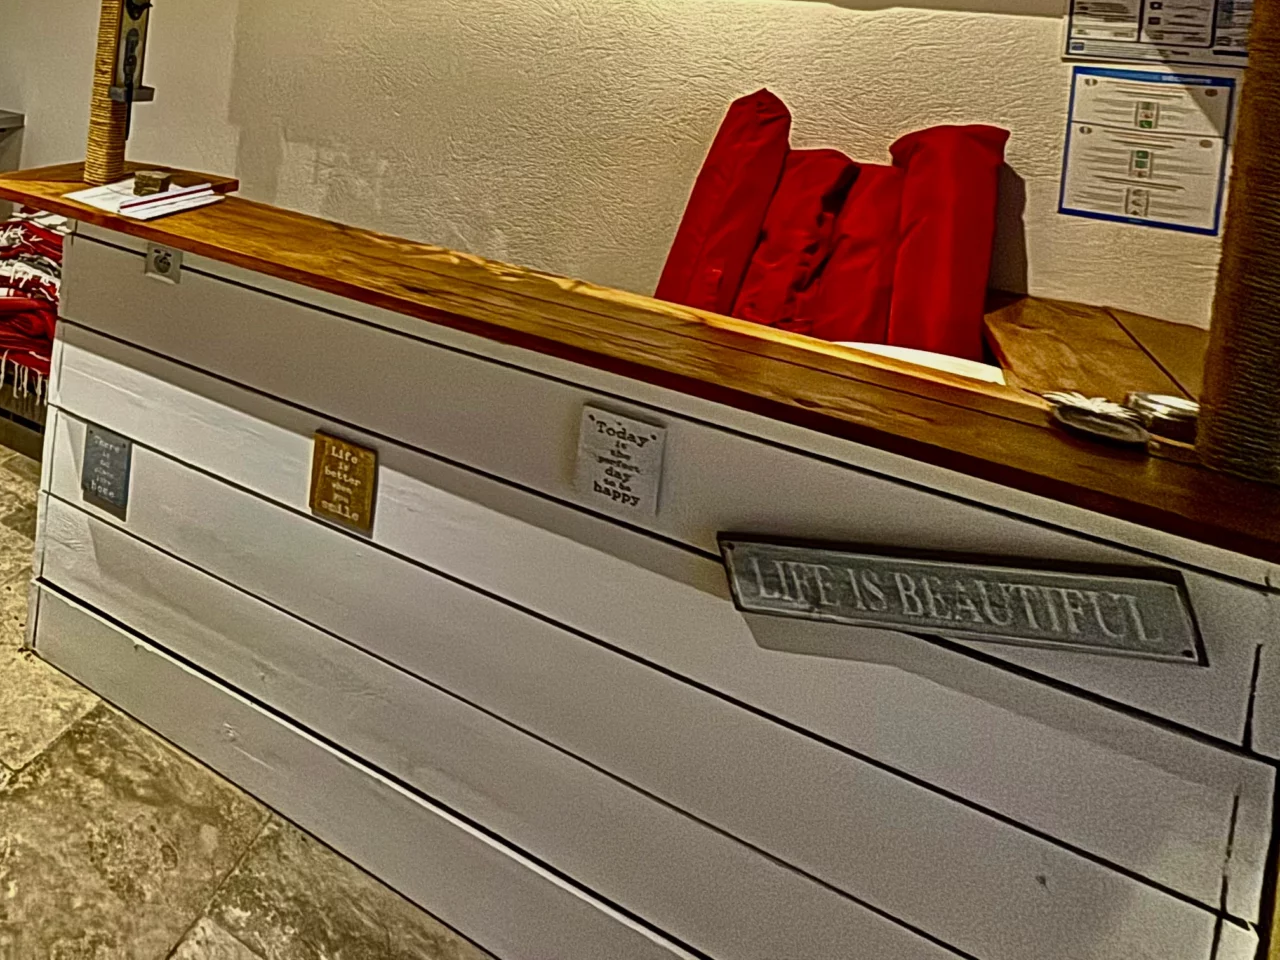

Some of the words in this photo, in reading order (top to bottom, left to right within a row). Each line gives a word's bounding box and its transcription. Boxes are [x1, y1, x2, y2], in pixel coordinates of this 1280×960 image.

[596, 420, 650, 448] Today
[331, 446, 358, 464] Life
[325, 465, 361, 486] better
[605, 466, 632, 483] day
[593, 480, 640, 507] happy
[749, 556, 846, 608] LIFE
[846, 566, 888, 611] IS
[893, 571, 1163, 641] BEAUTIFUL
